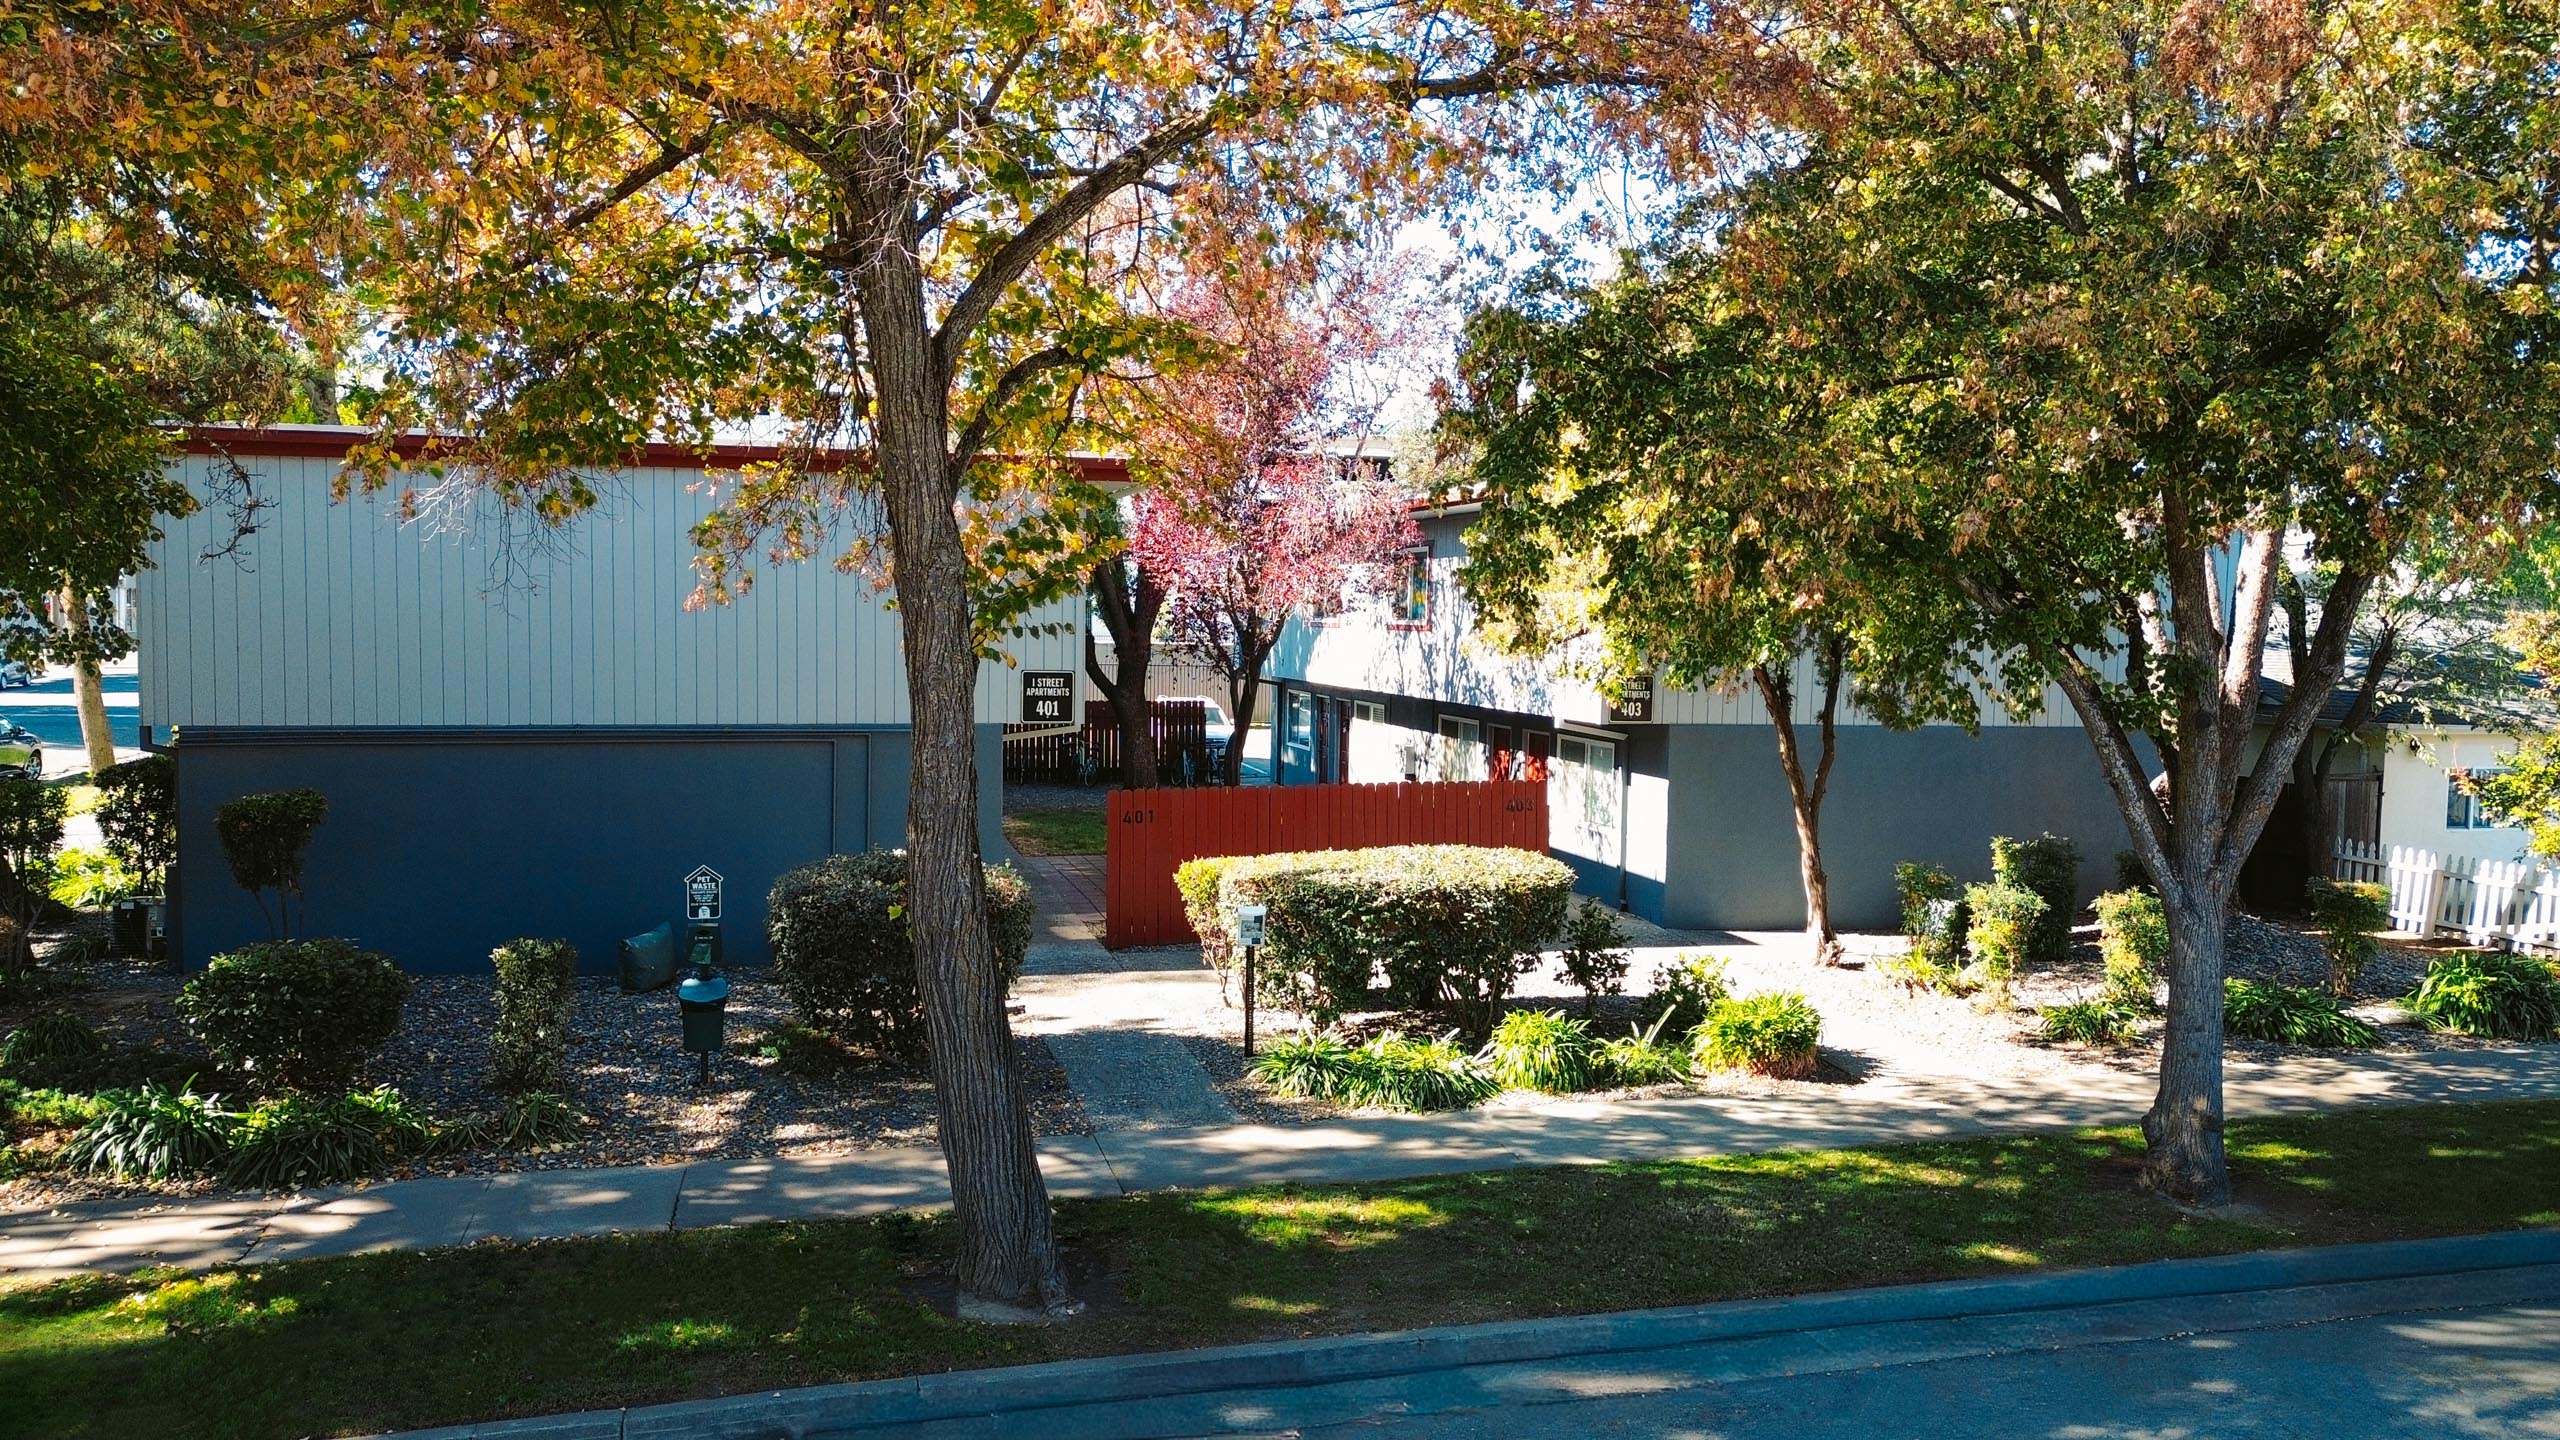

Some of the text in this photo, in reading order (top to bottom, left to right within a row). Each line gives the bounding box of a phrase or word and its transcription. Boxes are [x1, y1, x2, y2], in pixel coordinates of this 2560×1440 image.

[1037, 678, 1064, 687] STREET
[1026, 688, 1070, 697] APARTMENTS
[1036, 700, 1059, 716] 401
[1621, 702, 1642, 717] 403
[1506, 799, 1535, 812] 403
[1123, 810, 1154, 824] 401
